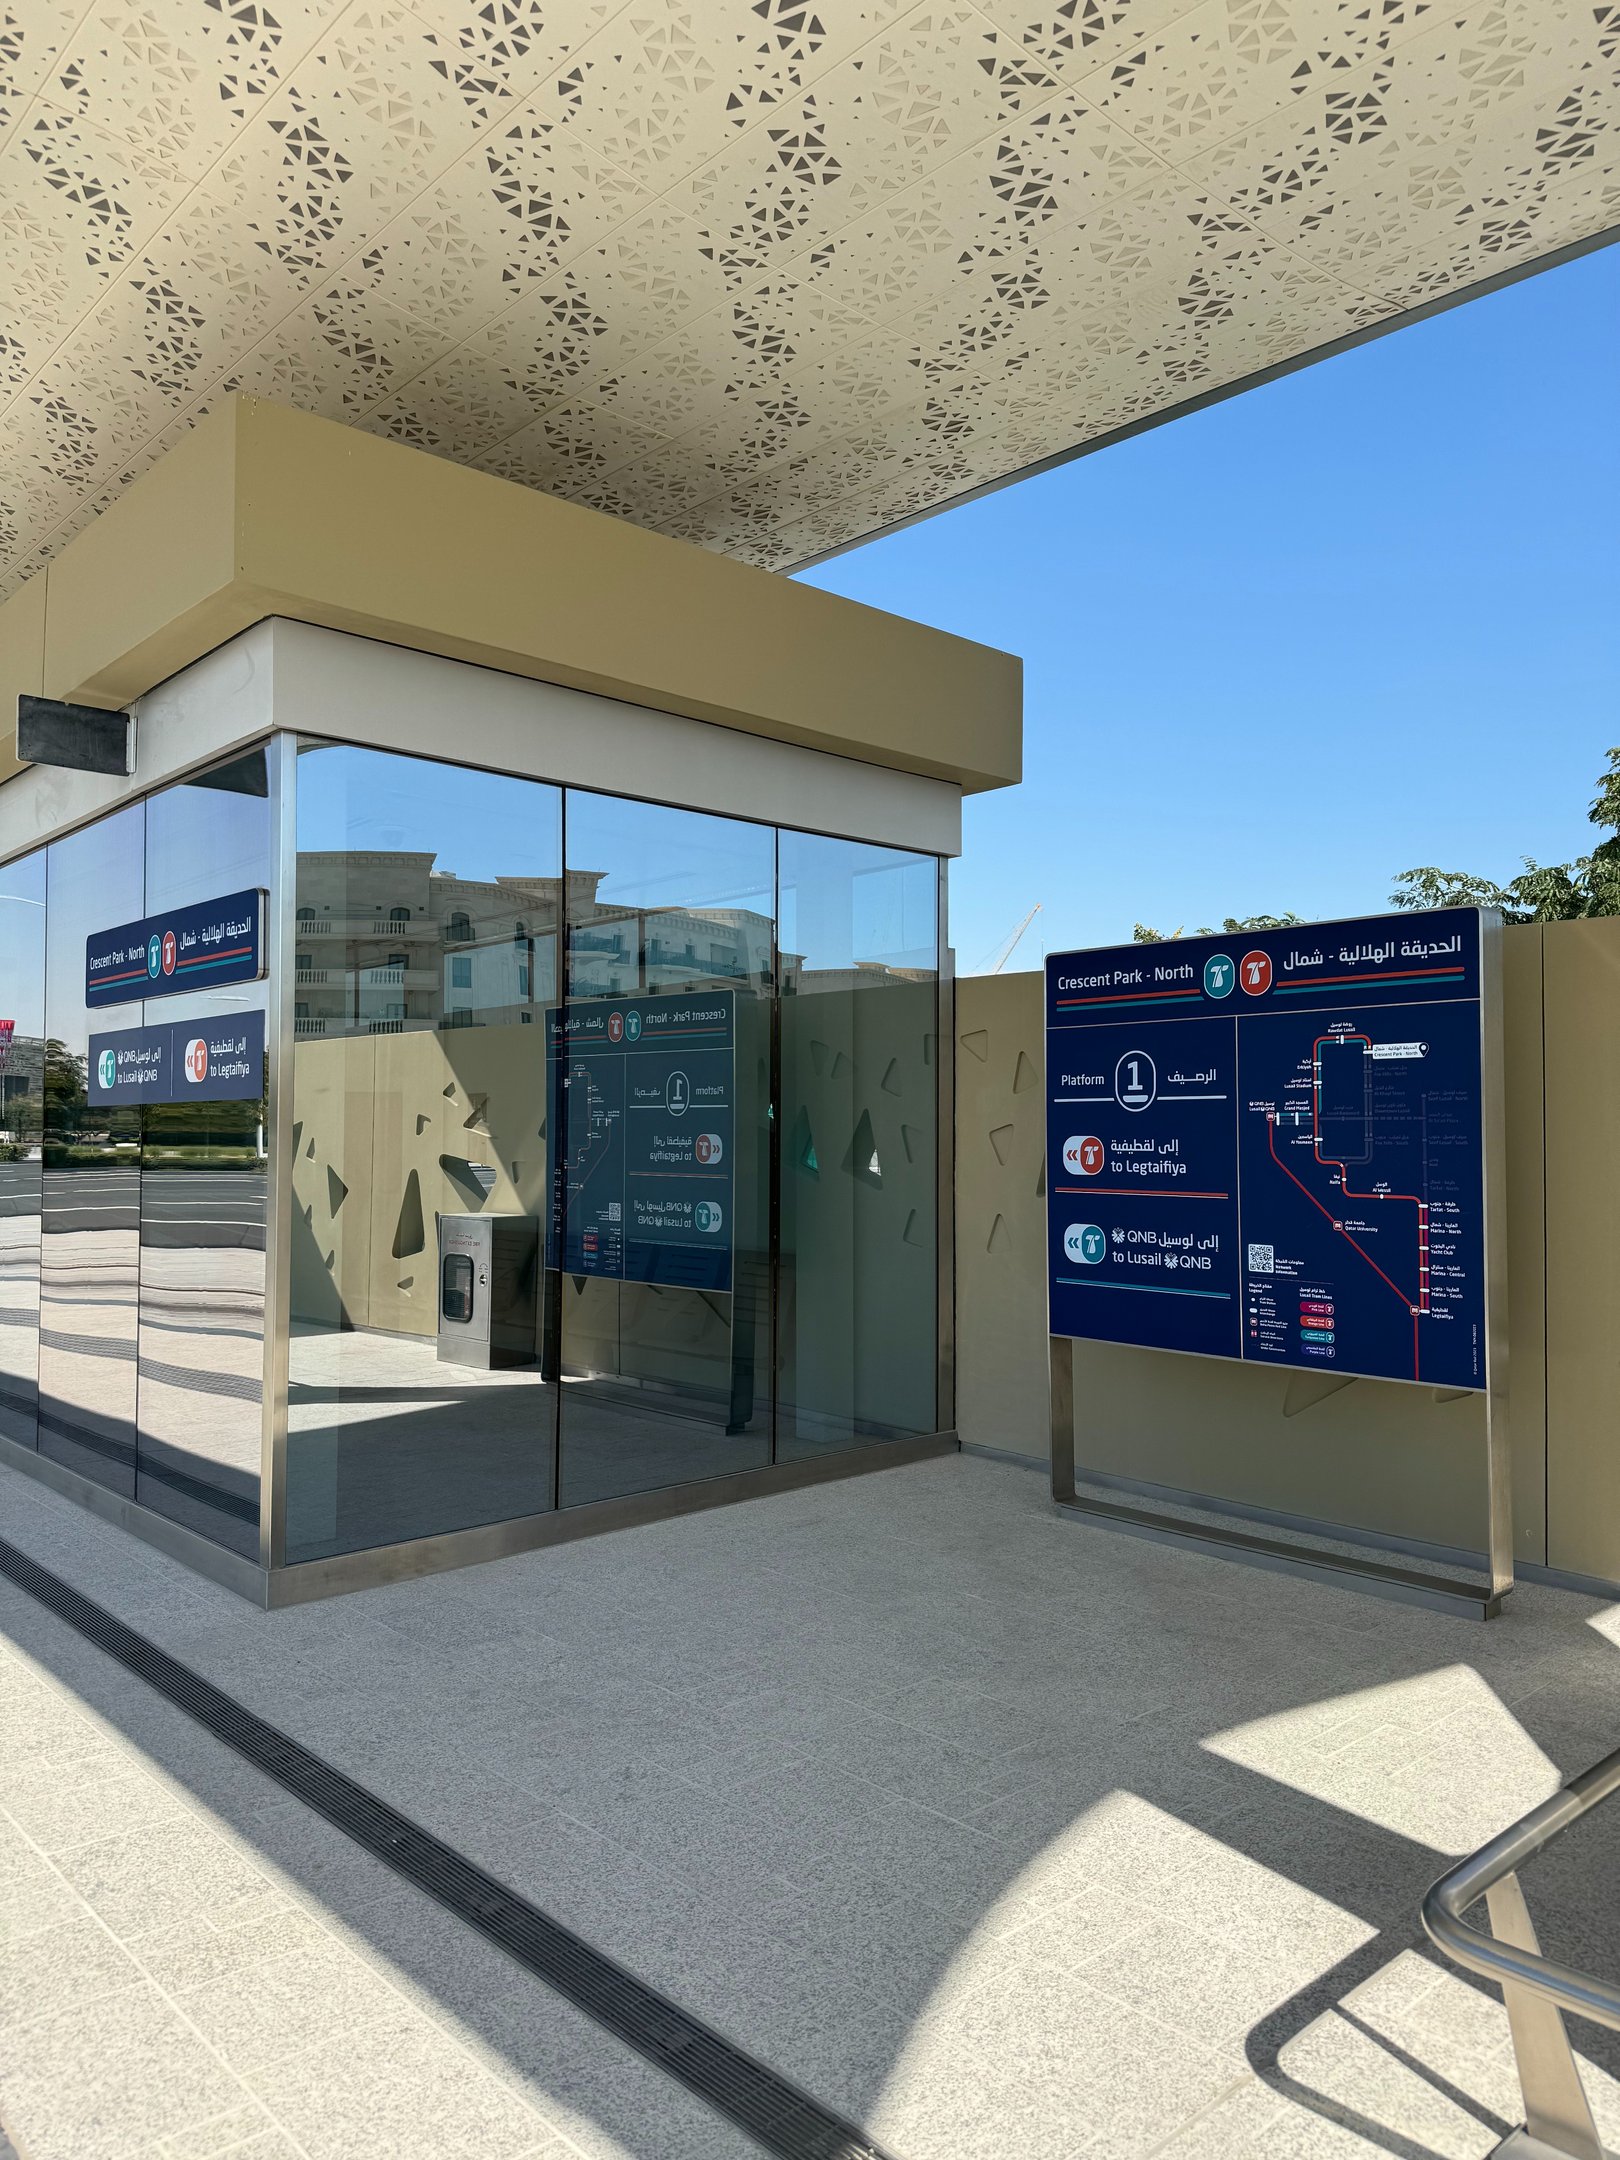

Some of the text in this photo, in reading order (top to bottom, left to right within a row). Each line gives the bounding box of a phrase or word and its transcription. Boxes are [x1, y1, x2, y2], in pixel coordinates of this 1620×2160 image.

[201, 924, 224, 944] الهلالية
[226, 916, 251, 938] الحديقة
[179, 930, 196, 950] شمال
[1400, 936, 1460, 958] الحديقة
[89, 954, 111, 970] Crescent
[112, 950, 124, 964] Park
[128, 944, 144, 960] North
[1283, 948, 1323, 970] شمال
[1338, 942, 1394, 966] الهلالية
[1058, 974, 1110, 990] Crescent
[1114, 968, 1142, 984] Park
[1154, 964, 1193, 982] North
[123, 1046, 161, 1064] إلى لوسيل QNB
[210, 1036, 246, 1056] إلى لقطيفية
[117, 1068, 157, 1084] to Lusail QNB
[210, 1060, 249, 1078] to Legtaifiya
[1061, 1060, 1143, 1090] Platform 1
[1167, 1068, 1216, 1084] الرصيف
[1110, 1138, 1178, 1156] إلى لقطيفية
[1110, 1160, 1186, 1176] to Legtaifiya
[1127, 1230, 1218, 1252] إلى لوسيل QNB
[1111, 1250, 1211, 1270] to Lusail QNB
